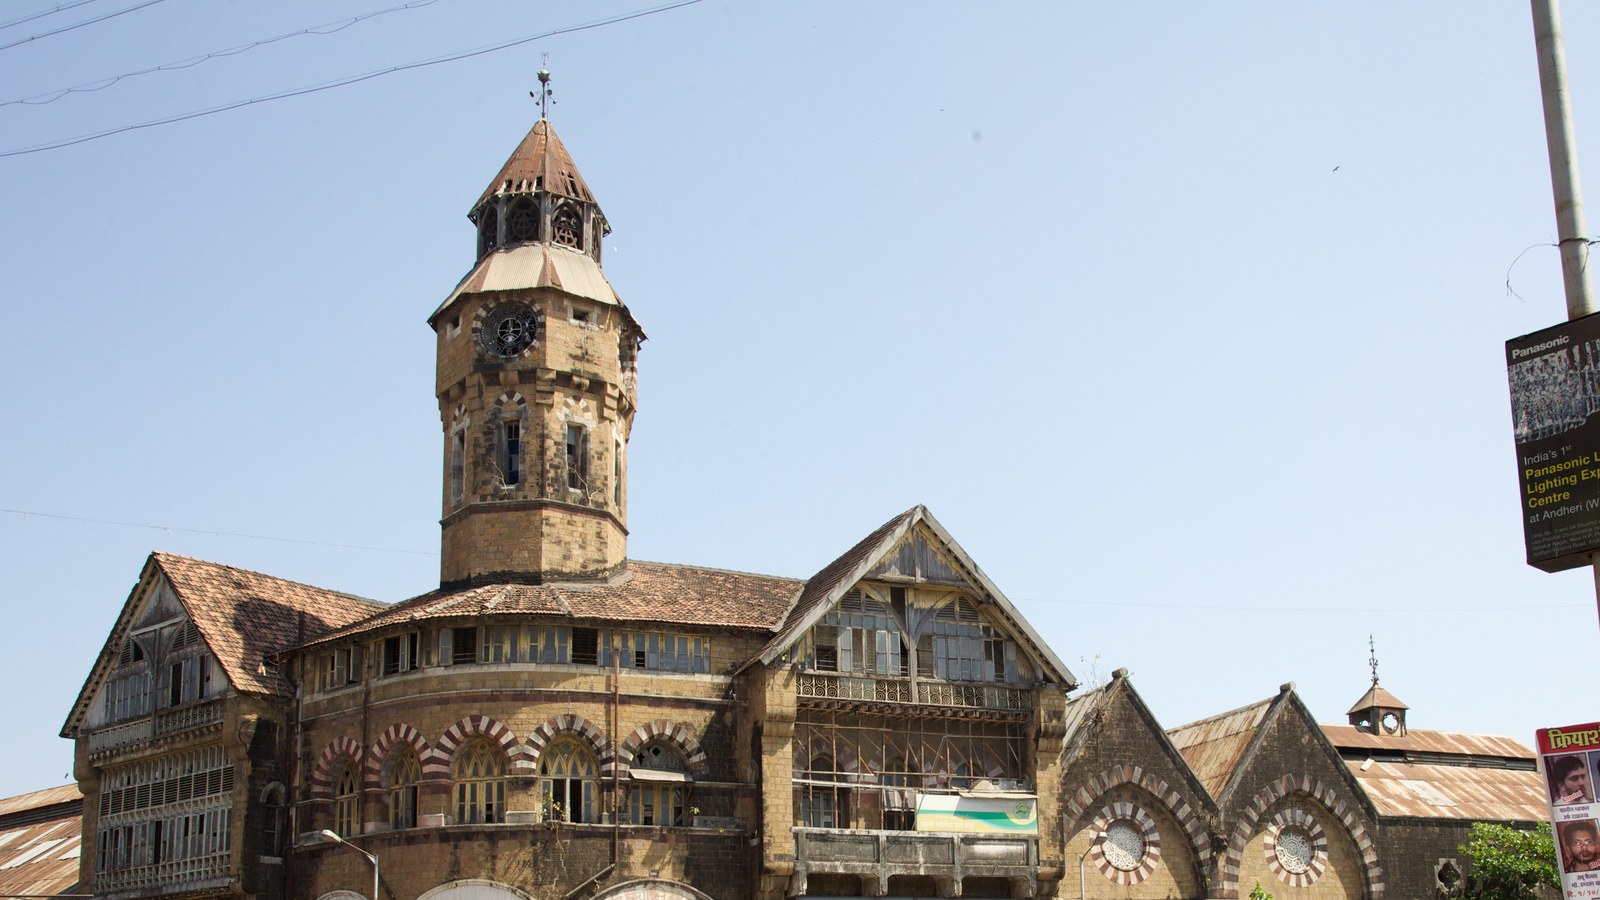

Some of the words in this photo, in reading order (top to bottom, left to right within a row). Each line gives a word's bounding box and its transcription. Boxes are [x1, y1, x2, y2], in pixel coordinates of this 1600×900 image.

[1512, 335, 1570, 359] Panasonic
[1524, 450, 1557, 466] India's
[1525, 456, 1590, 479] Panasonic
[1527, 474, 1577, 494] Lighting
[1528, 491, 1570, 508] Centre
[1529, 513, 1540, 524] at
[1542, 502, 1583, 520] Andheri
